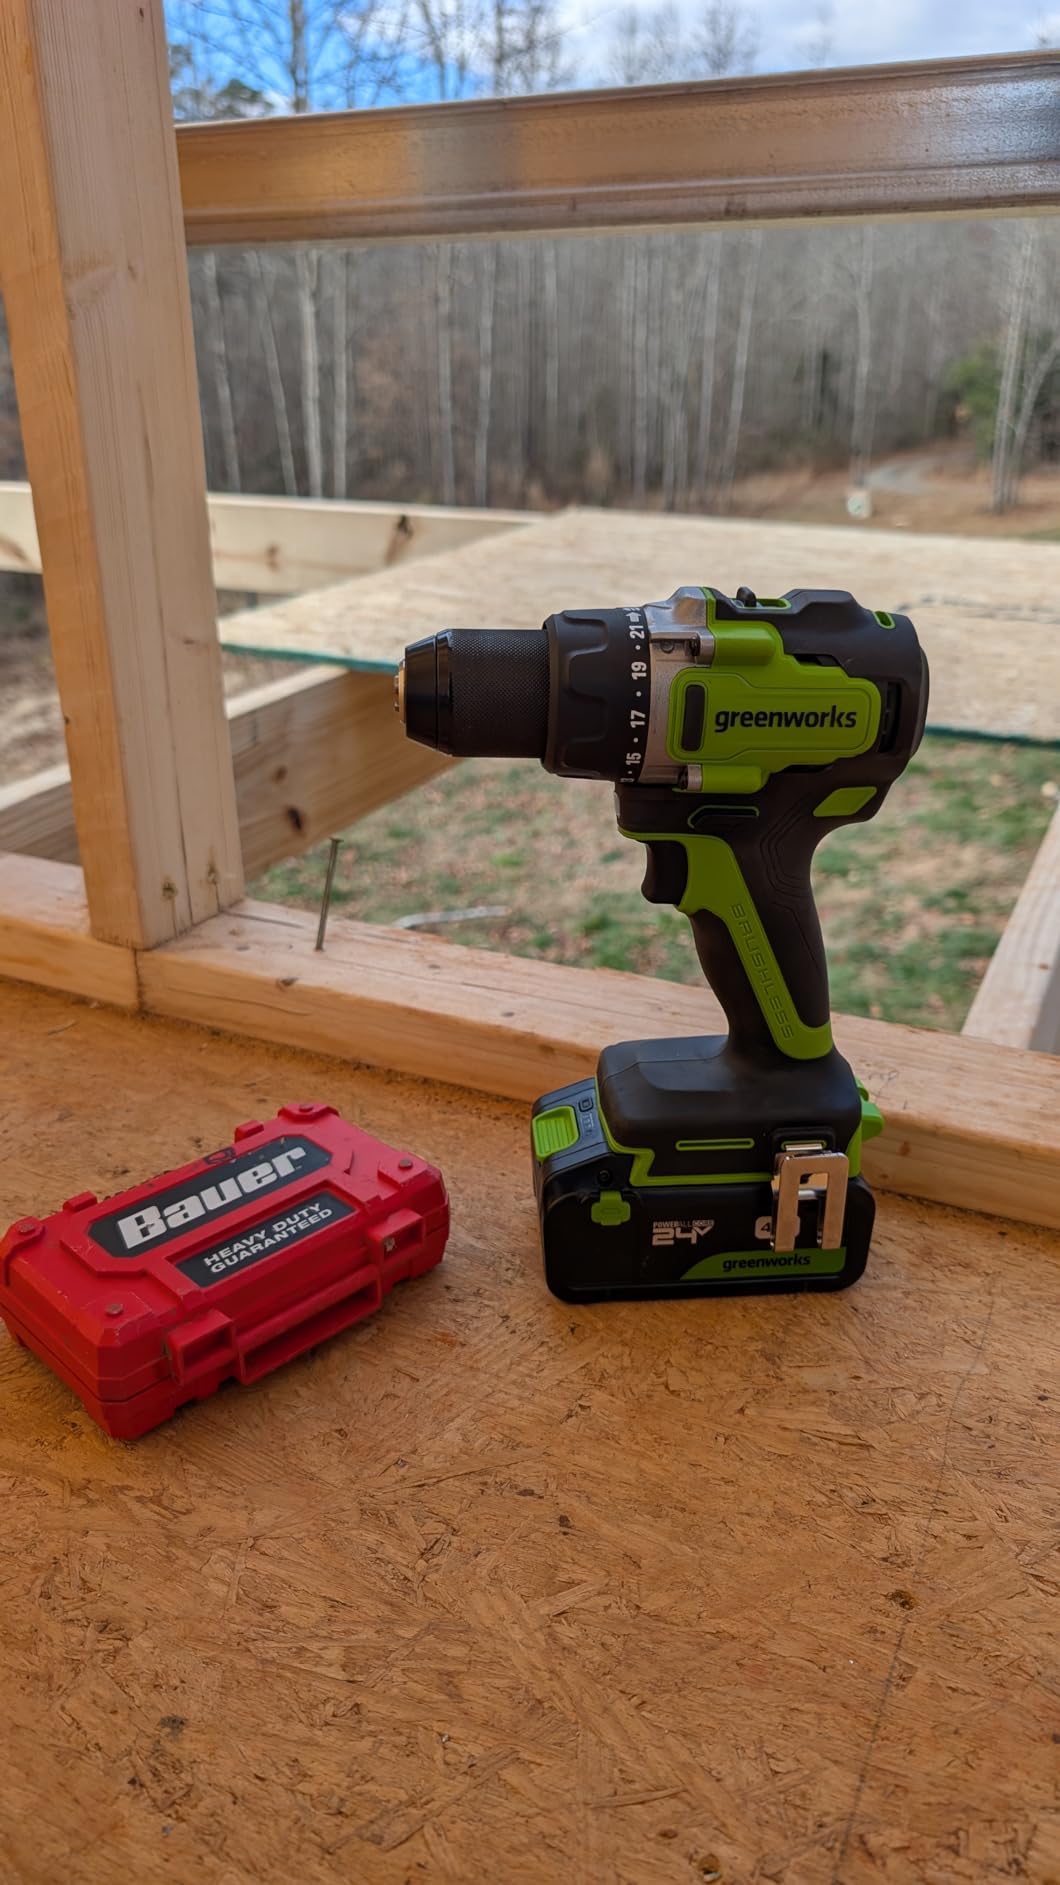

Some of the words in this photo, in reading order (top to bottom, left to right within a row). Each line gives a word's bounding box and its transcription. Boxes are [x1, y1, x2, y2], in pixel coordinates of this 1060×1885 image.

[629, 625, 645, 639] 21
[631, 661, 647, 680] 19
[630, 709, 646, 728] 17
[714, 705, 857, 733] greenworks
[625, 752, 642, 766] 15
[730, 903, 795, 1039] BRUSHLESS
[117, 1146, 307, 1249] Bauer
[203, 1230, 267, 1267] HEAVY
[272, 1203, 322, 1232] DUTY
[210, 1208, 334, 1274] GUARANTEED
[722, 1253, 811, 1273] greenworks
